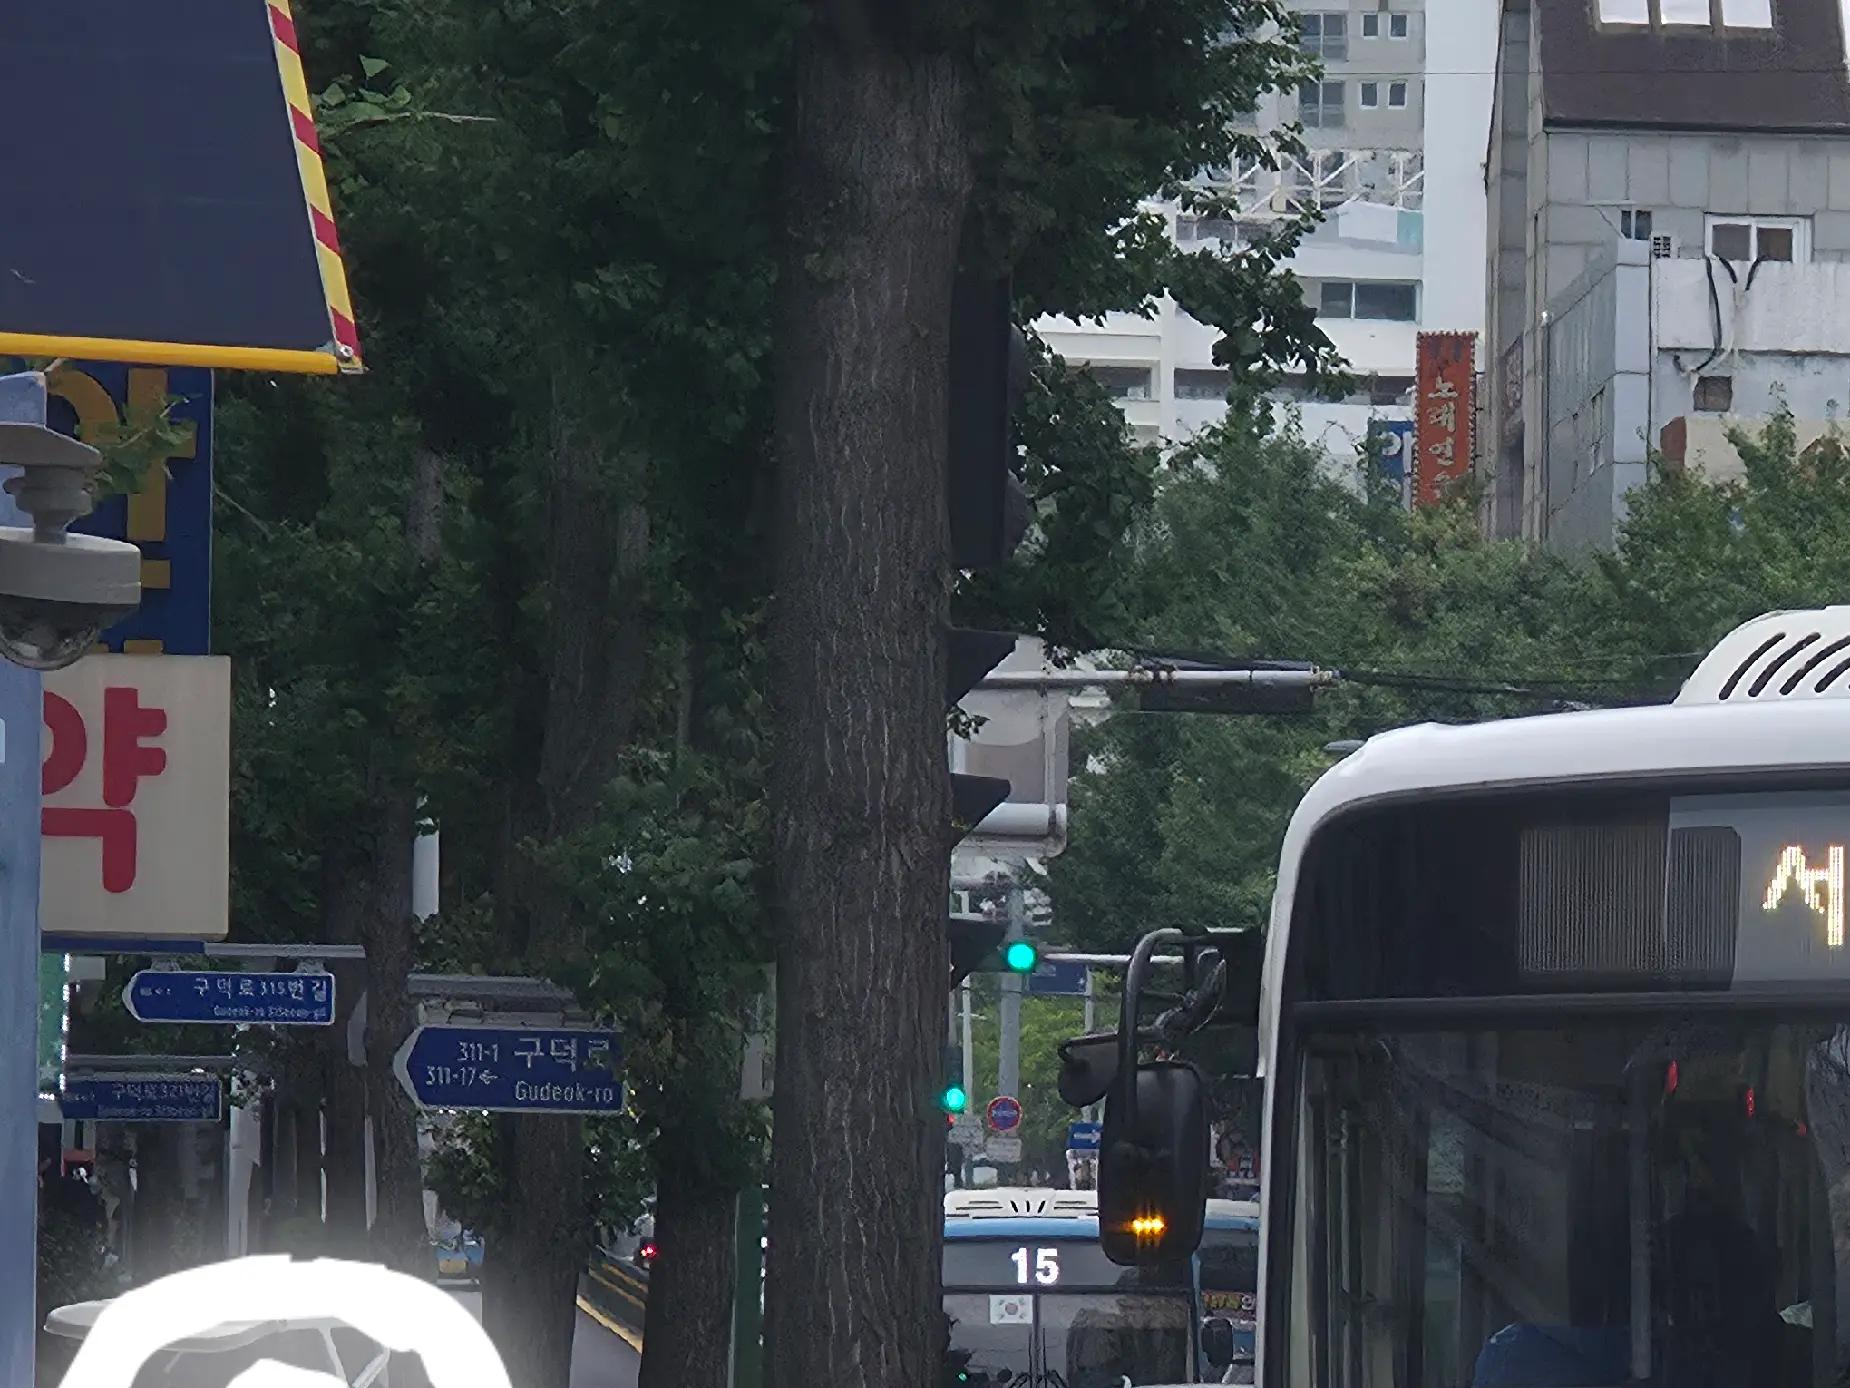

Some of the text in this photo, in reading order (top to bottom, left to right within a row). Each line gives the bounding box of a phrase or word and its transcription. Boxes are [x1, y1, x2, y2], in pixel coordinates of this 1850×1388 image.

[456, 1041, 499, 1063] 311-1
[425, 1065, 477, 1087] 311-17
[514, 1079, 614, 1104] Gudeok-ro
[1011, 1247, 1060, 1285] 15
